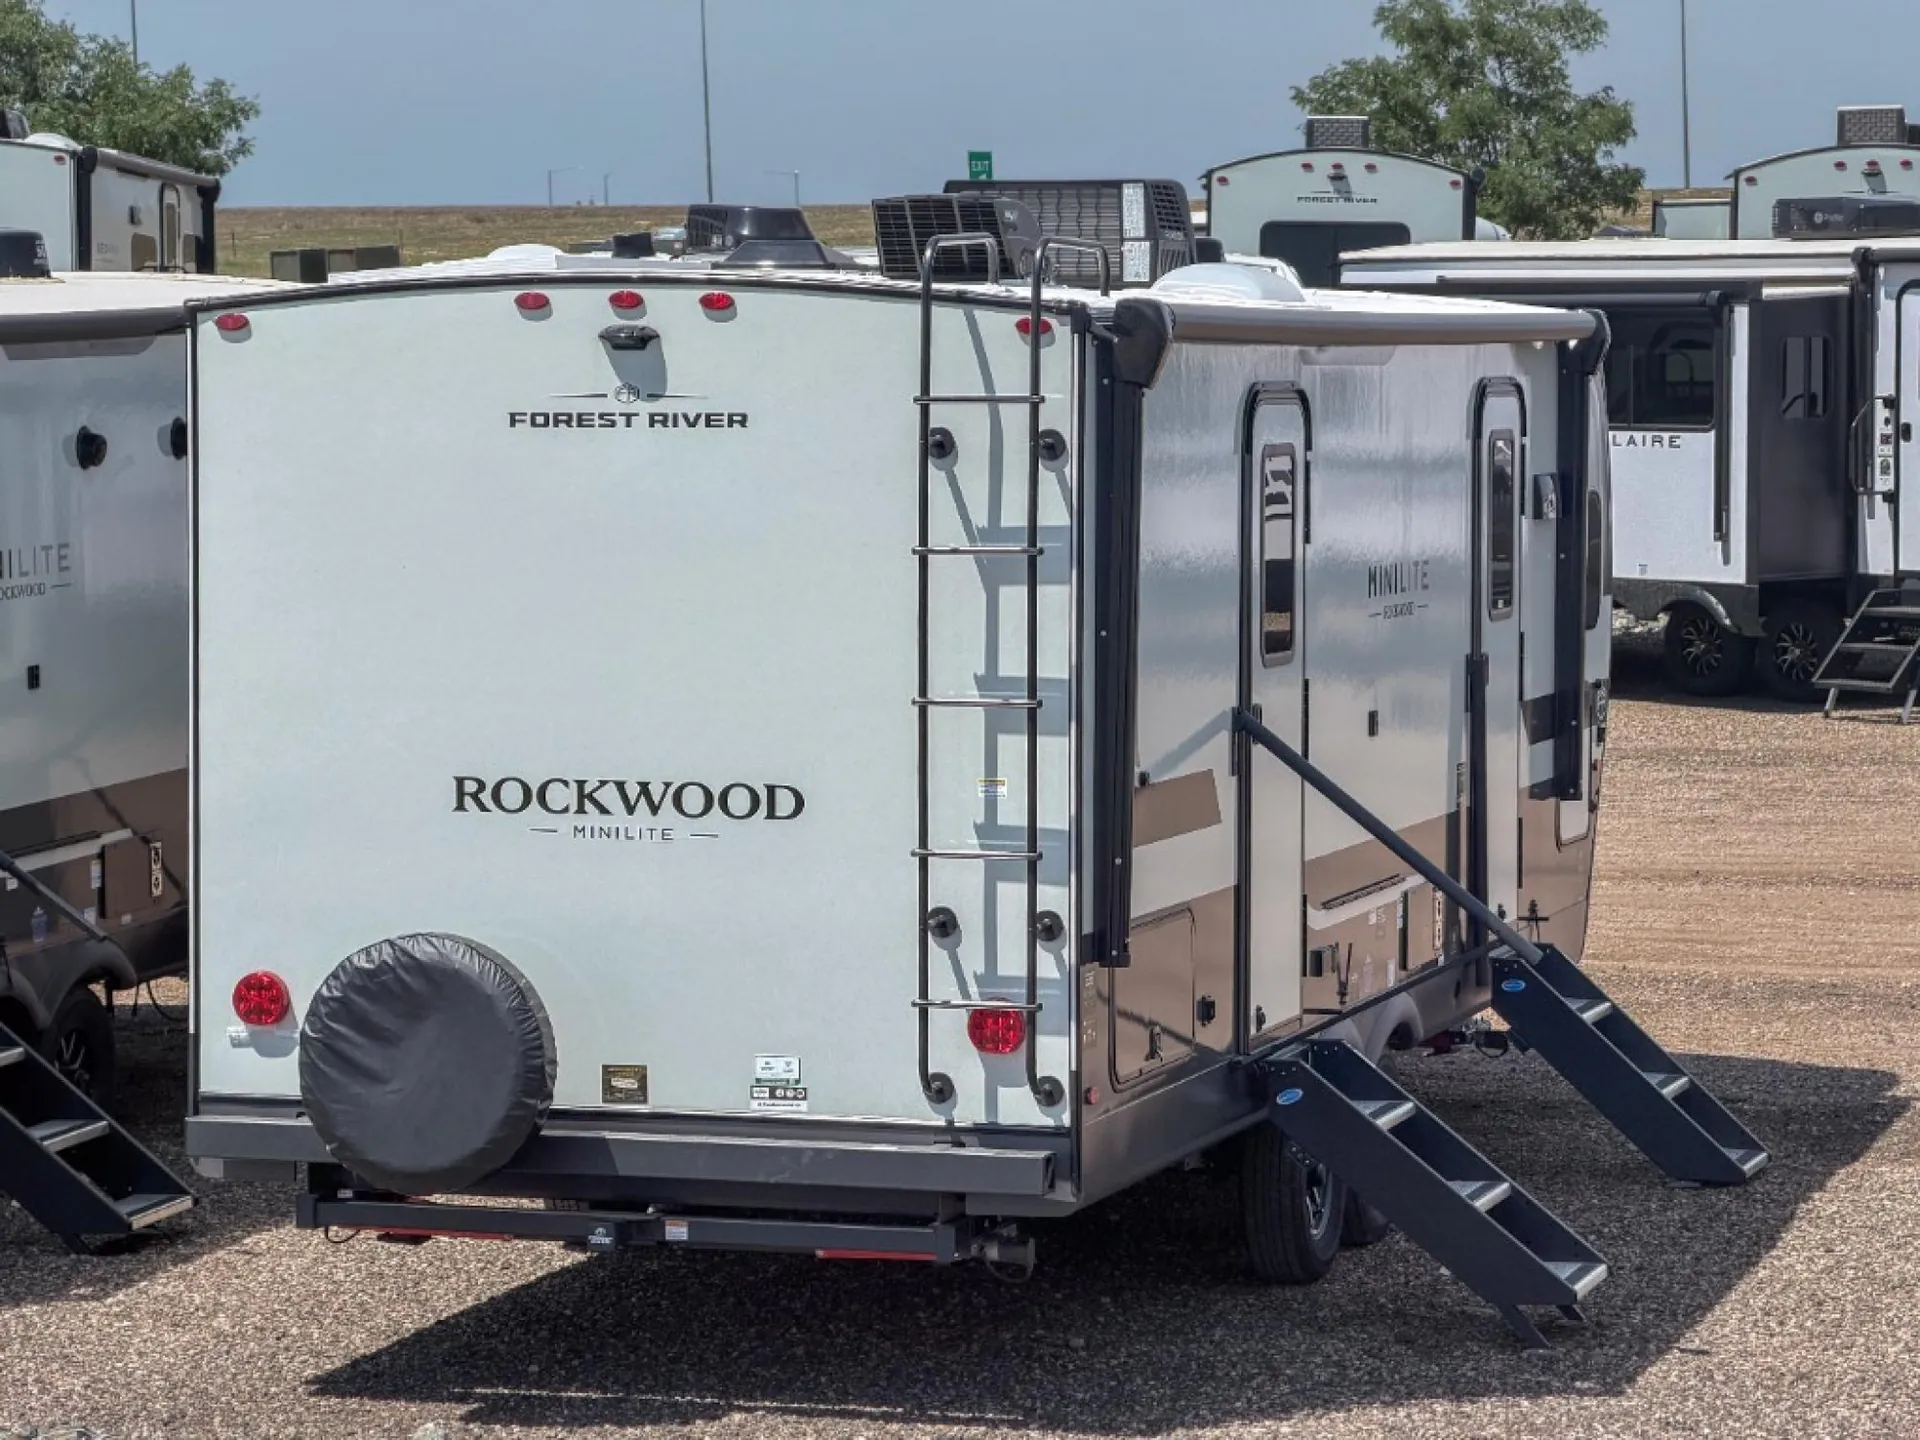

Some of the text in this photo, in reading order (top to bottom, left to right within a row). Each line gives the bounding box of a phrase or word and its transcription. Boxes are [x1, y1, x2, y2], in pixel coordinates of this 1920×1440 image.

[507, 411, 749, 428] FOREST RIVER
[1368, 560, 1429, 599] MINILITE
[452, 775, 806, 820] ROCKWOOD
[573, 824, 675, 841] MINILITE
